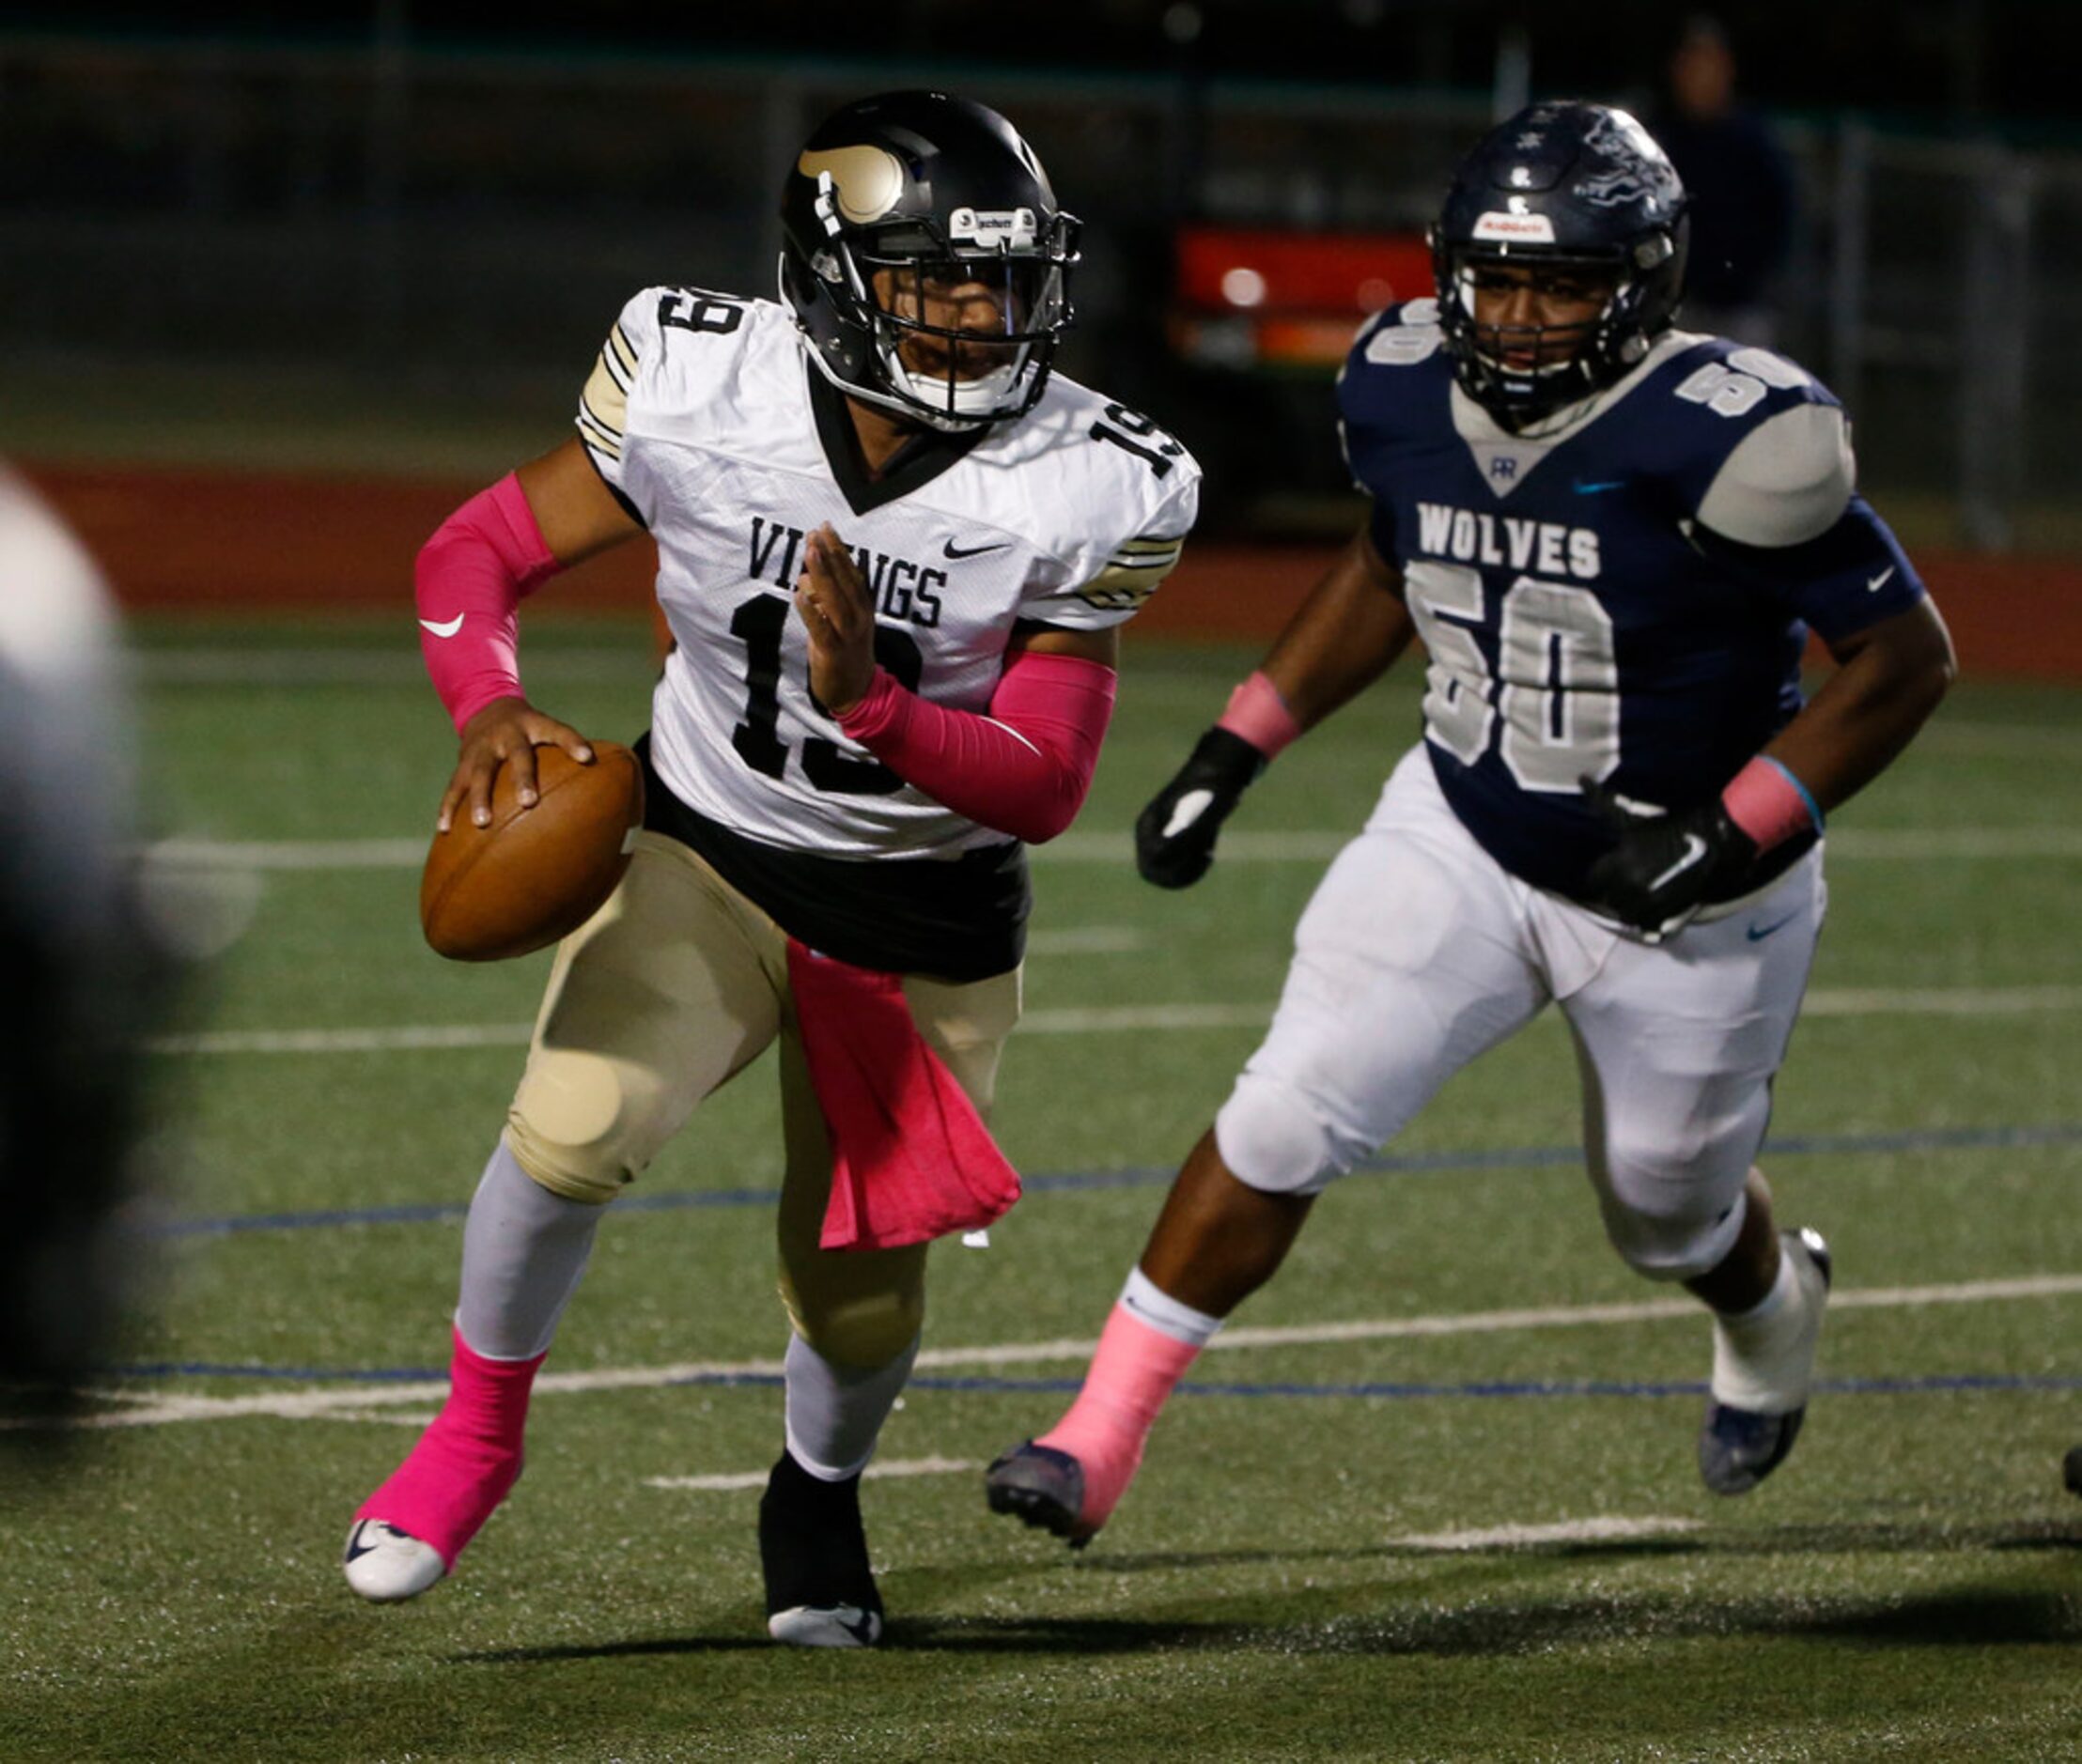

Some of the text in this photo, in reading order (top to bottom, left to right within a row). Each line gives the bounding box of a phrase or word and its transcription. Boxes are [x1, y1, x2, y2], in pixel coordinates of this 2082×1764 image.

[1674, 348, 1811, 418] 50
[1089, 404, 1186, 480] 19
[750, 516, 948, 628] VINGS
[1416, 502, 1602, 580] WOLVES
[1403, 559, 1623, 796] 50
